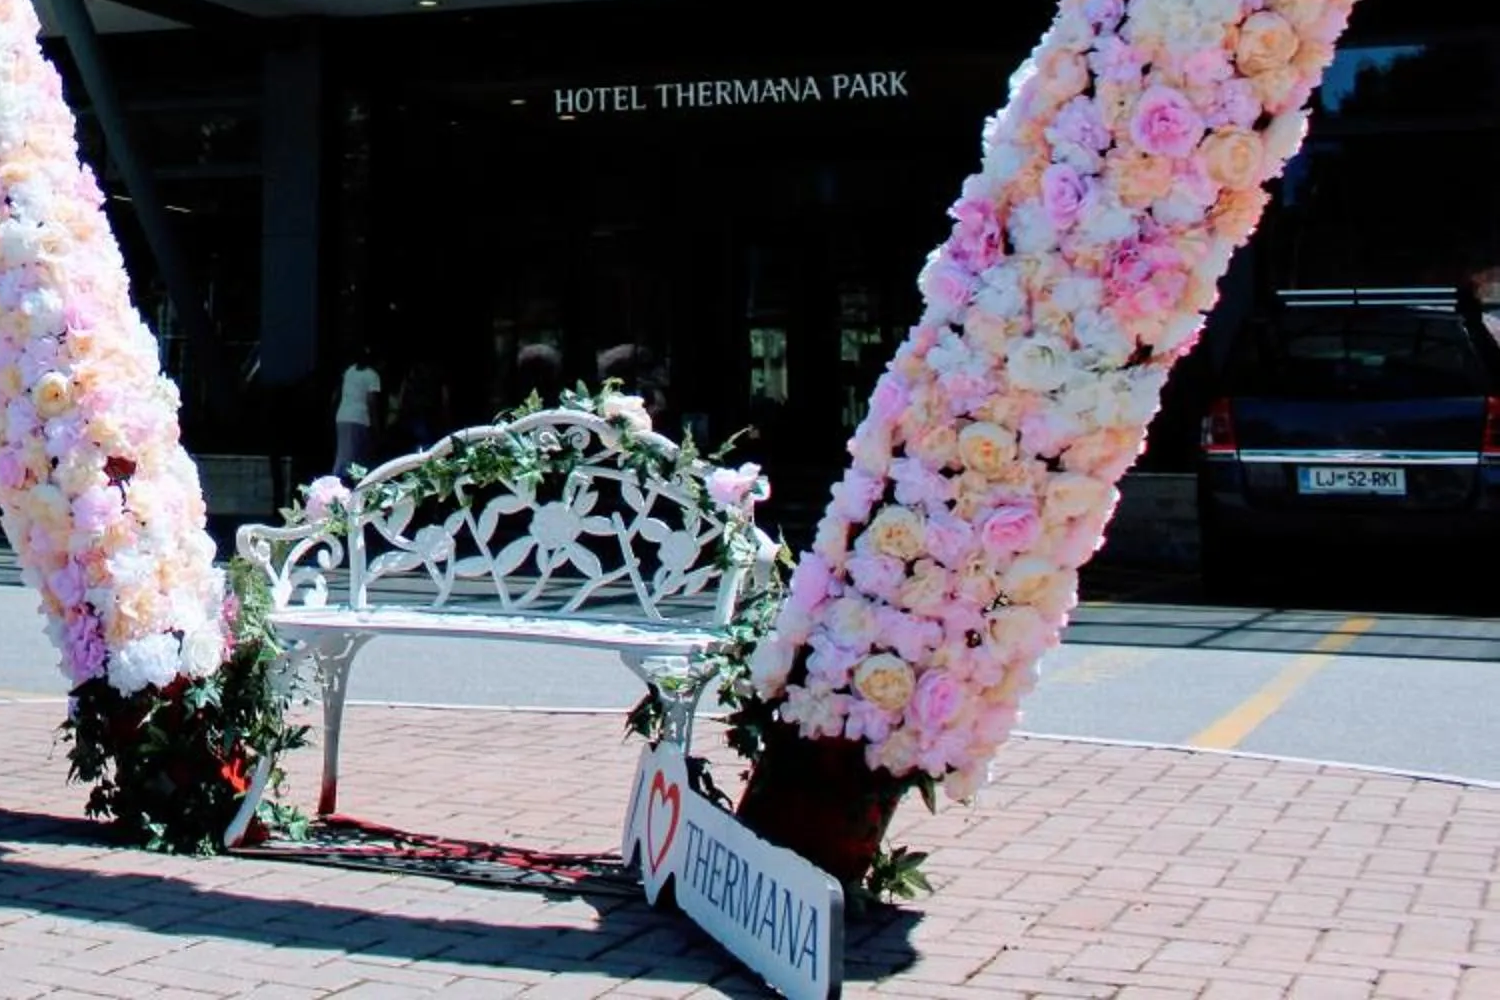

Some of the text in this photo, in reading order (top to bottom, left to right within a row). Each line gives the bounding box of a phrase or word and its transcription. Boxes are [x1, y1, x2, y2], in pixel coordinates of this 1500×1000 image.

[555, 71, 908, 113] HOTEL THERMANA PARK
[683, 819, 819, 981] THERMANA
